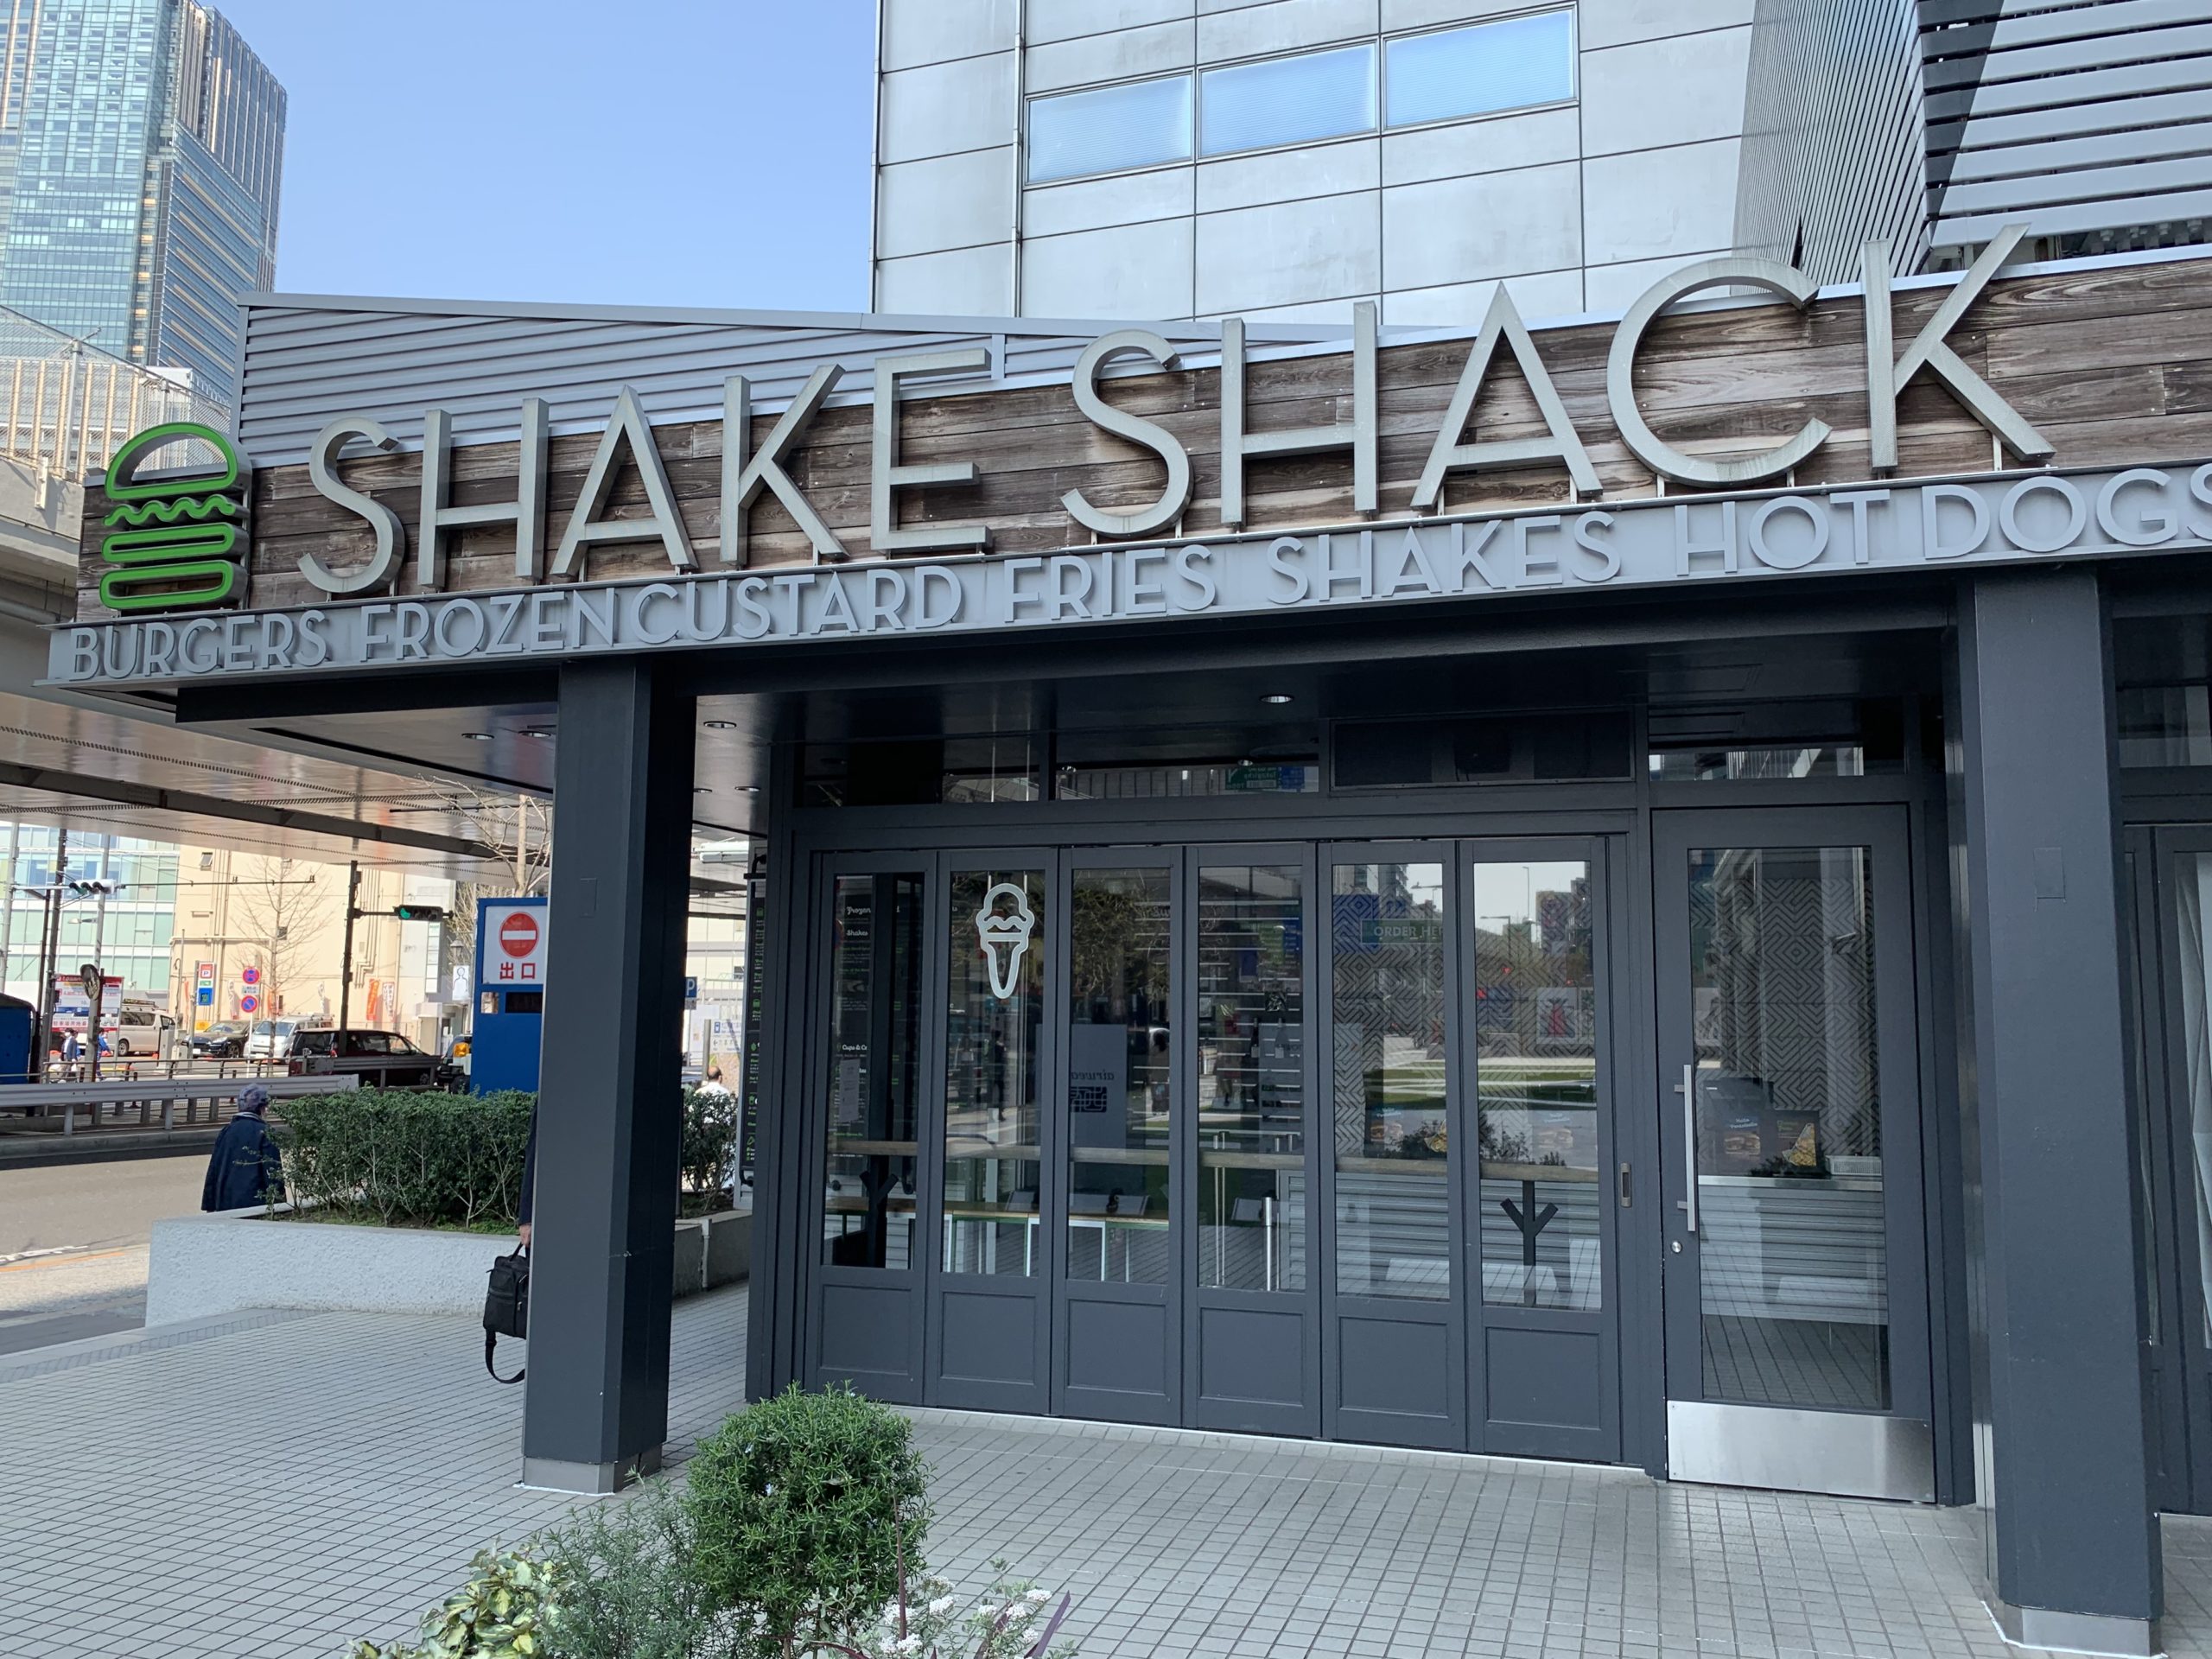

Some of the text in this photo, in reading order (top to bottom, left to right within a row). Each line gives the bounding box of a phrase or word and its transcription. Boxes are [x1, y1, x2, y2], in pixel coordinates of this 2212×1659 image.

[297, 222, 2058, 594] SHAKE SHACK
[72, 608, 329, 681] BURGERS
[359, 588, 616, 663] FROZEN
[630, 565, 963, 644] CUSTARD
[1003, 543, 1216, 625] FRIES
[1265, 511, 1621, 605] SHAKES
[1675, 488, 1891, 576] HOT
[1373, 925, 1416, 937] ORDER
[499, 962, 536, 980] 出口
[686, 978, 696, 996] P
